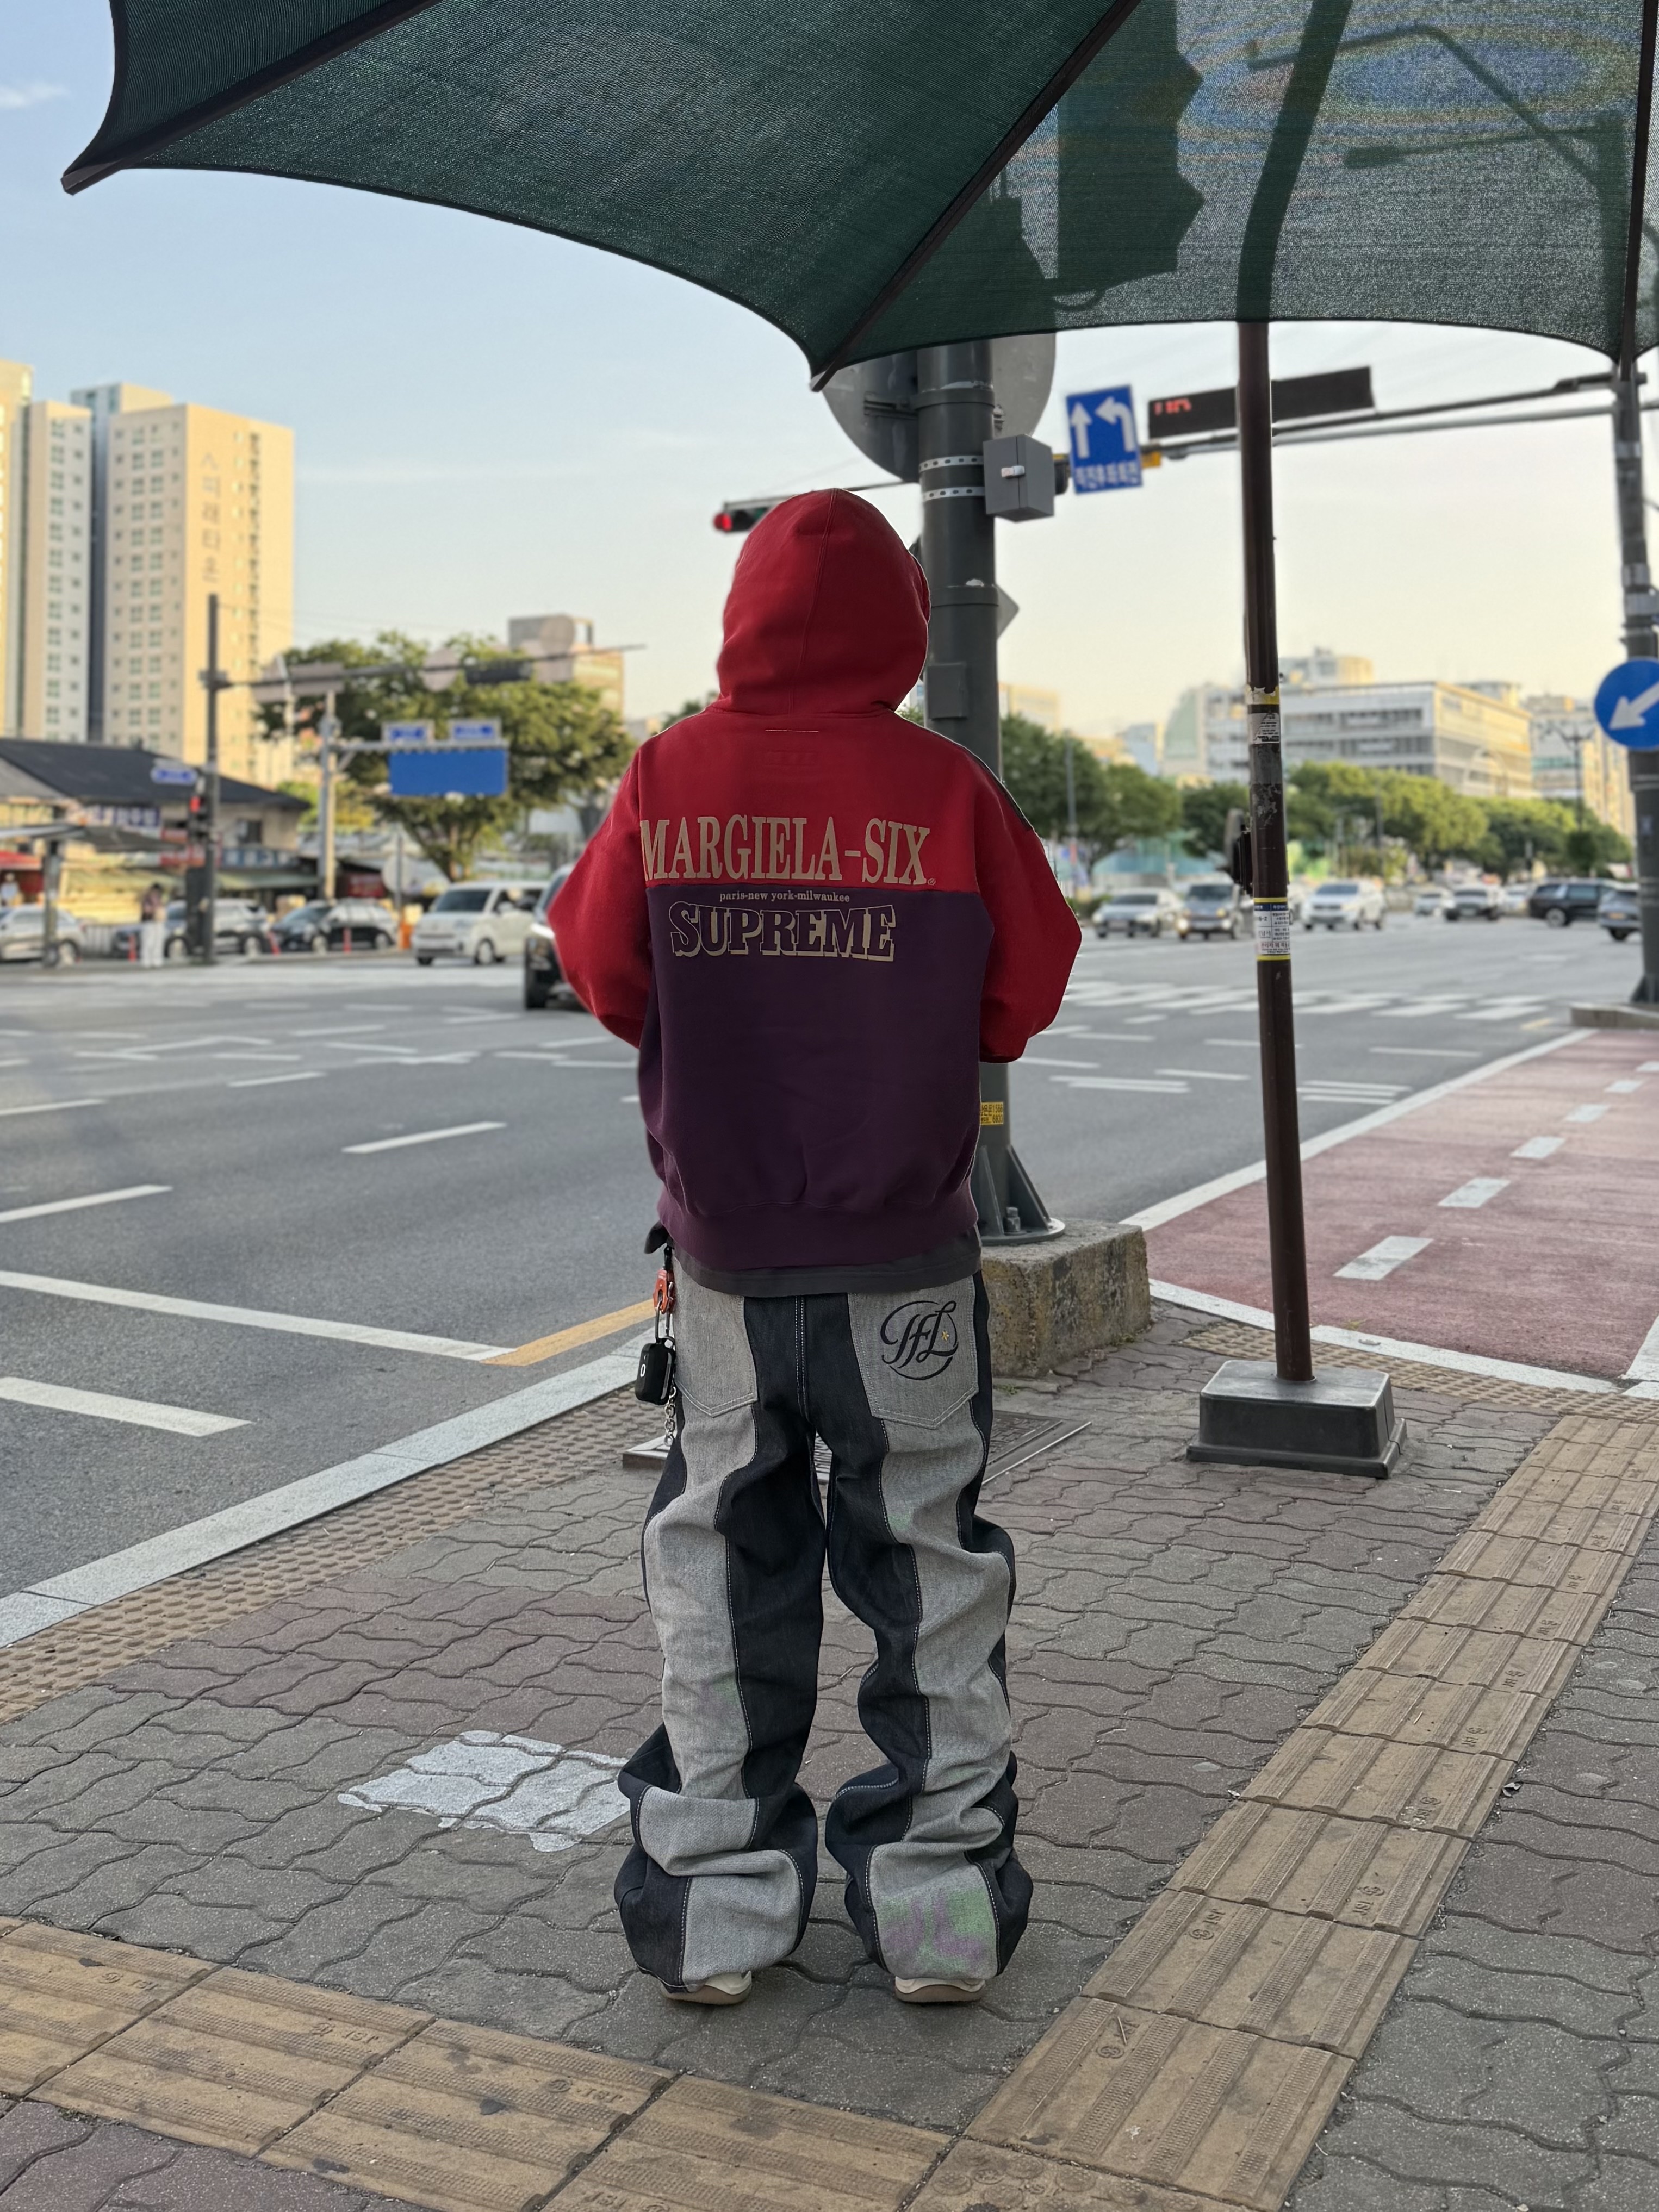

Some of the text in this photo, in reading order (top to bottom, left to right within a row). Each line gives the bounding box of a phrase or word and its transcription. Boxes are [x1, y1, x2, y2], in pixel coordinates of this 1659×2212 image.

[720, 890, 850, 902] paris-new york-milwaukee
[669, 901, 896, 962] SUPREME
